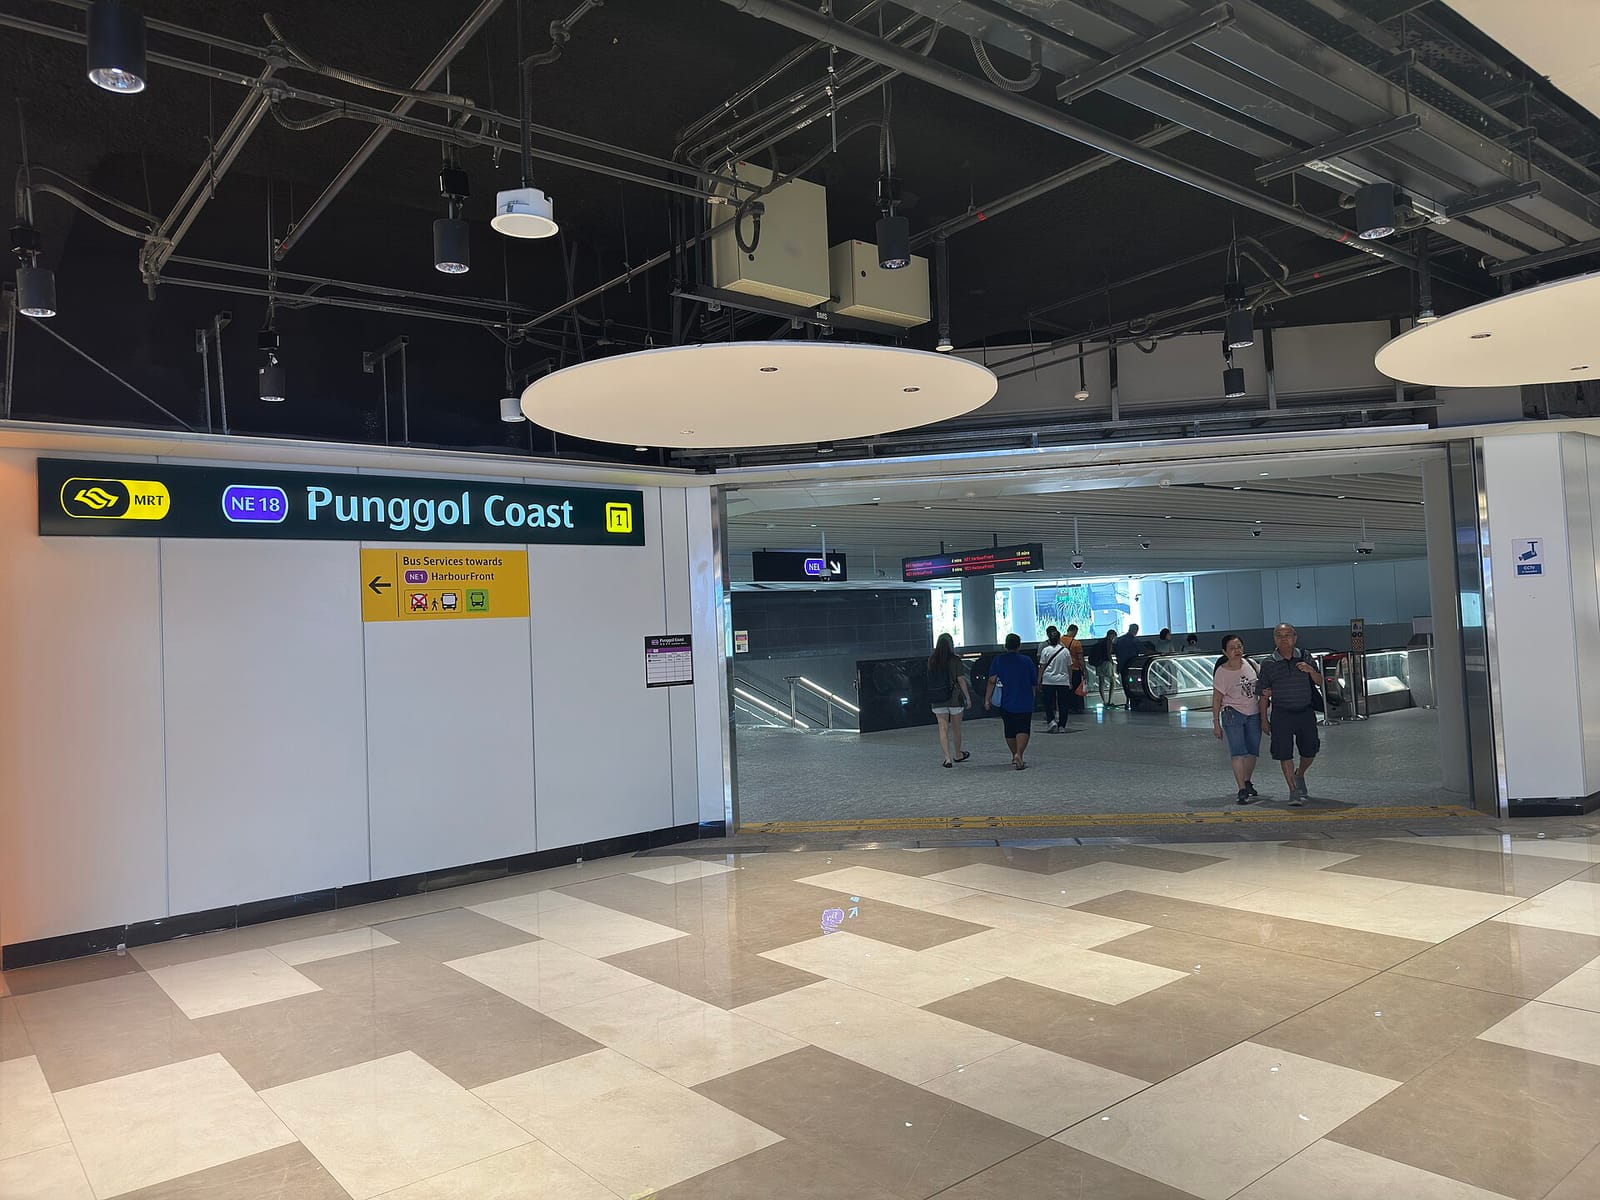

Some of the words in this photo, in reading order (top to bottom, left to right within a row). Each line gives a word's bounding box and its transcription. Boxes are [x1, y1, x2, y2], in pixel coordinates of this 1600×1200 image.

[134, 495, 164, 506] MRT
[231, 496, 255, 511] NE
[259, 497, 281, 512] 18
[306, 486, 471, 531] Punggol
[484, 494, 574, 529] Coast
[615, 513, 623, 527] 1
[403, 556, 421, 566] Bus
[423, 556, 464, 566] Services
[466, 556, 503, 566] towards
[431, 572, 495, 581] HarbourFront
